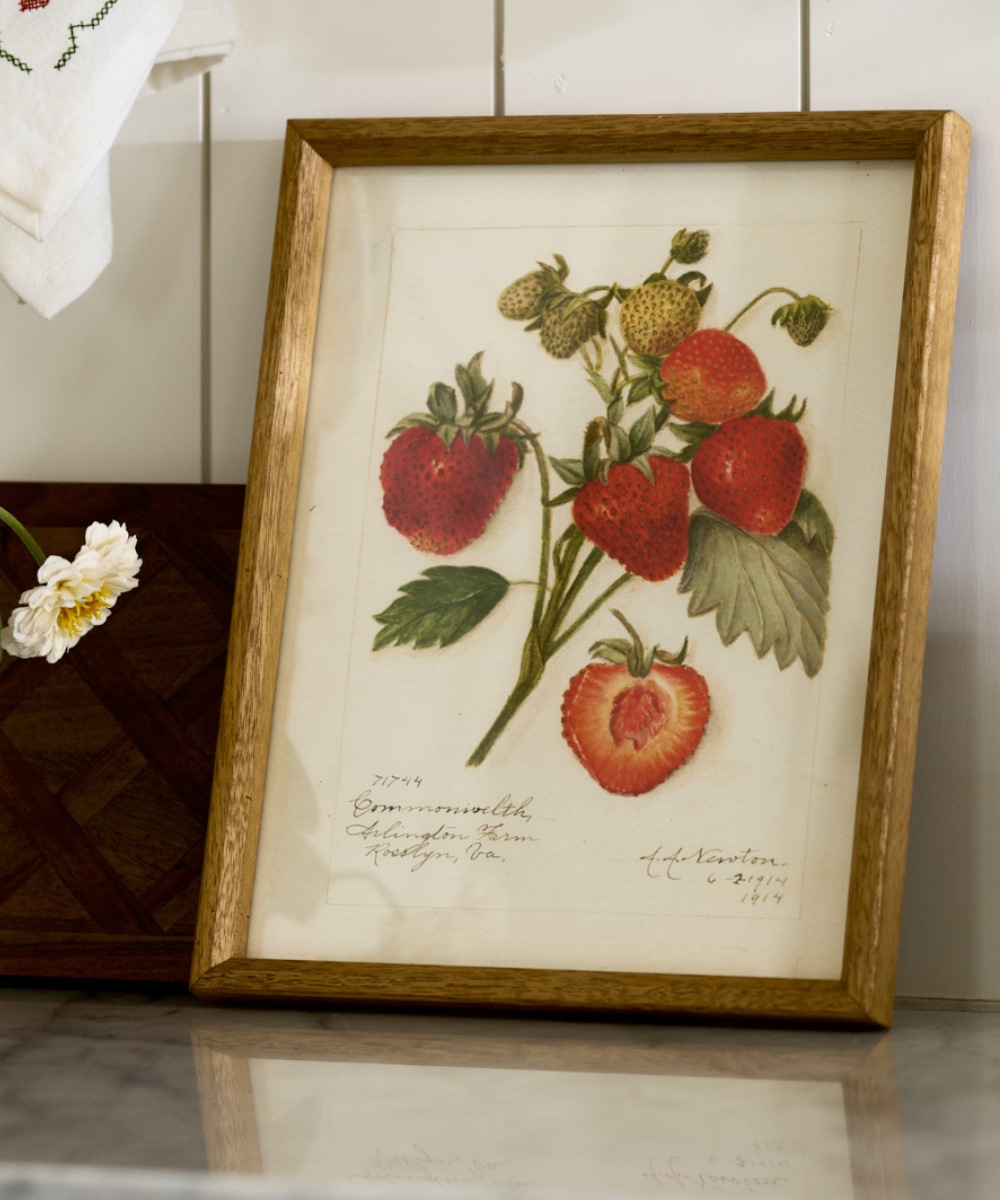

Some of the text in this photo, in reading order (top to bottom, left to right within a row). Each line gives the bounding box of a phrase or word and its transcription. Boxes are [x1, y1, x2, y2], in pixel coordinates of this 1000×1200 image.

[372, 775, 423, 788] 71744
[346, 821, 540, 850] Arlington Farm
[741, 893, 784, 905] 1914
